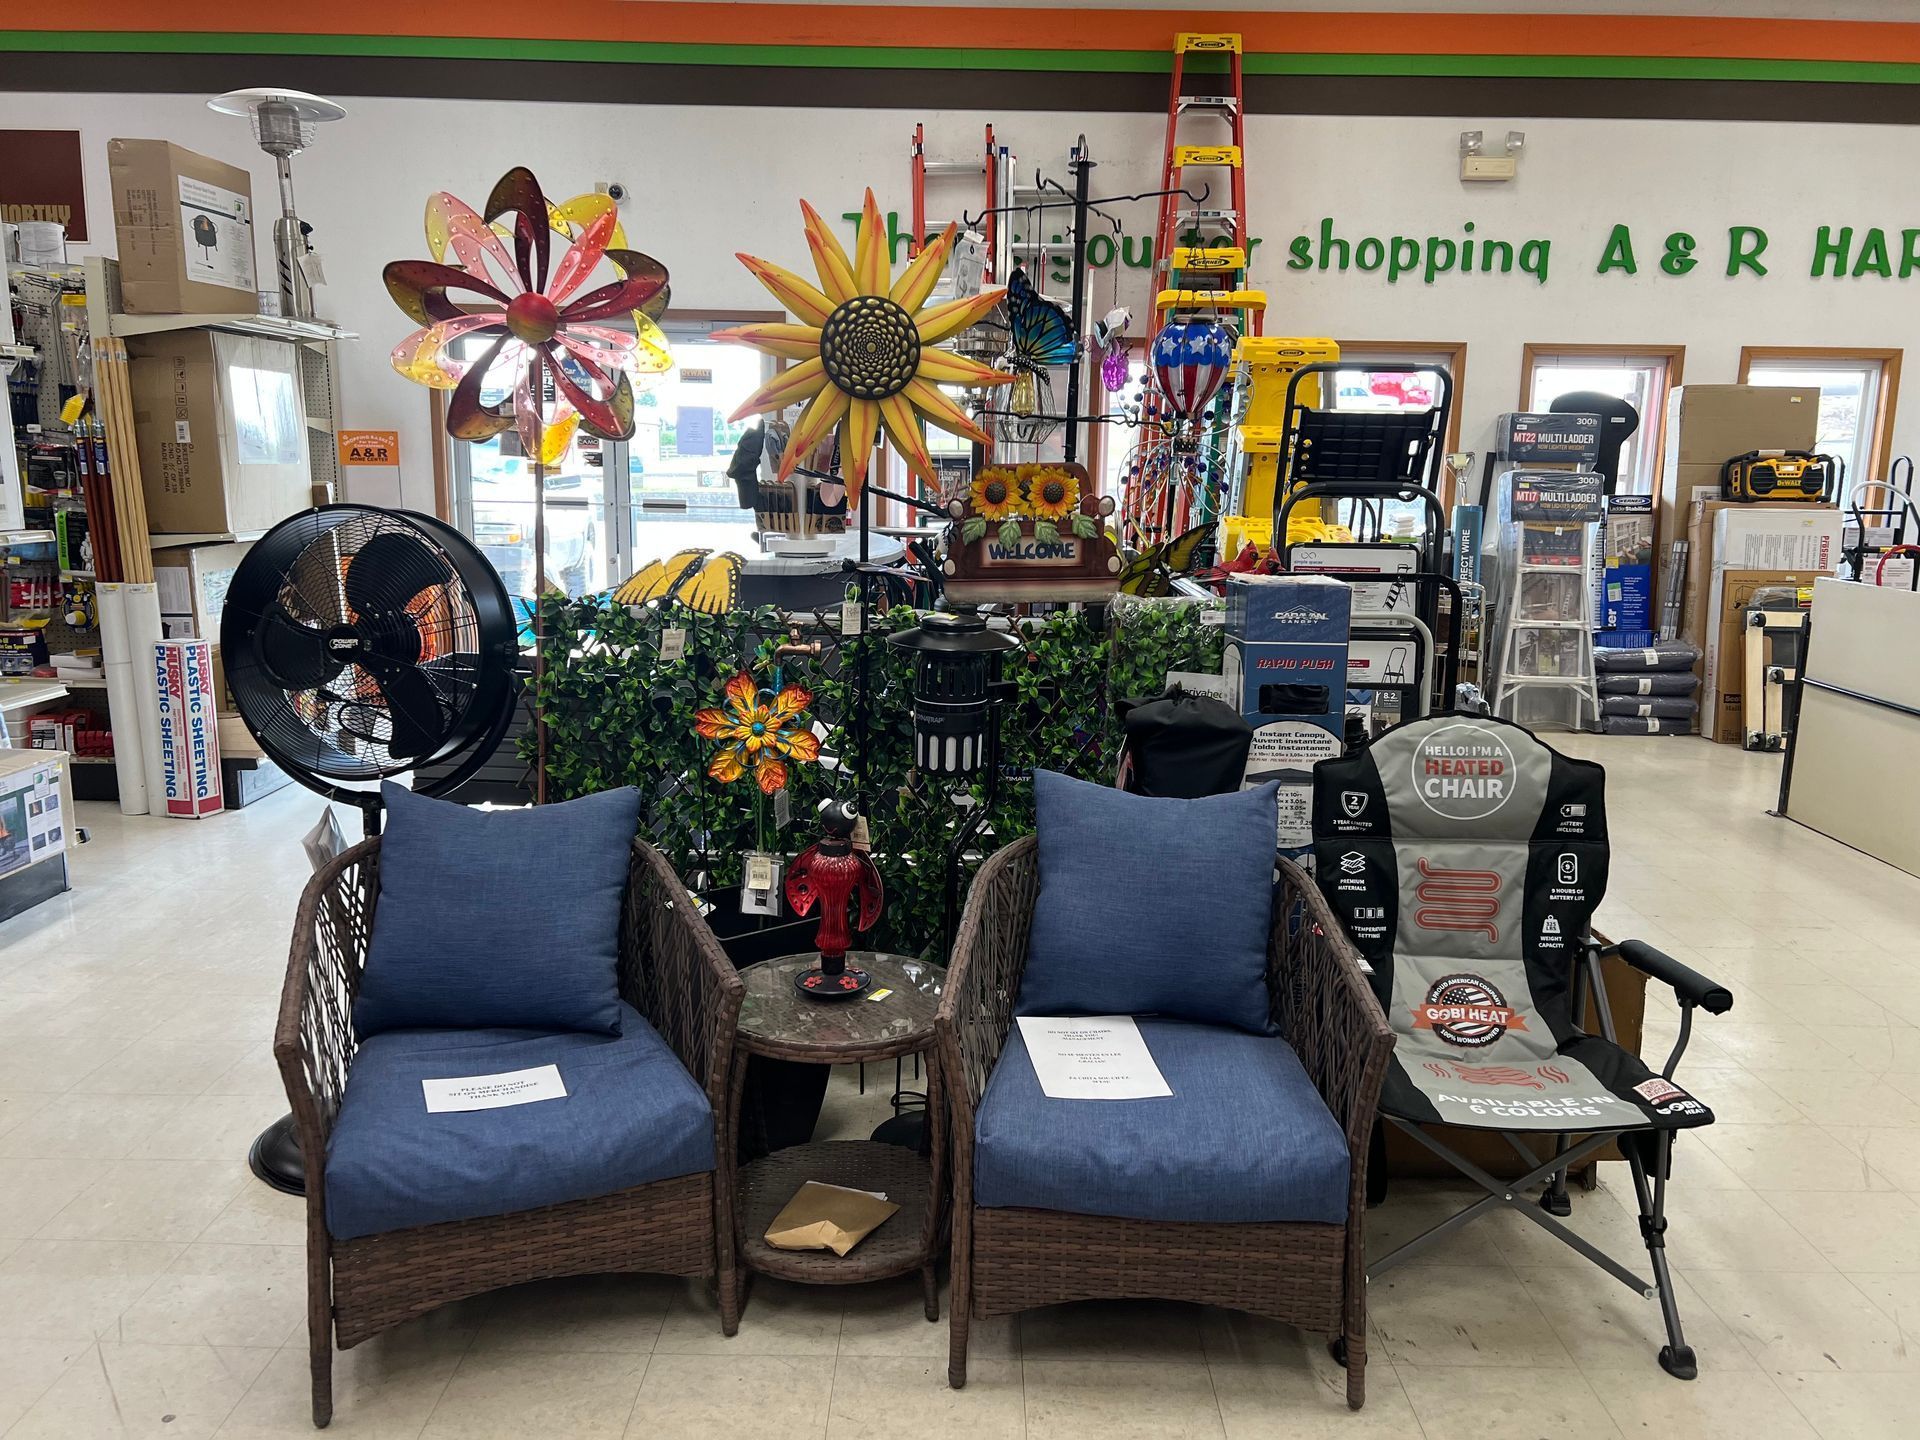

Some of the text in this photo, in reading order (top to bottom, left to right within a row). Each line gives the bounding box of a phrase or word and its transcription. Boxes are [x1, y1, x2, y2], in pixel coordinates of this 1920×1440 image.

[1, 204, 70, 226] ORTHY
[1597, 224, 1638, 275] A
[1660, 232, 1699, 275] &
[1726, 226, 1768, 277] R
[1513, 432, 1594, 444] MT22 MULTI LADDER
[1515, 491, 1597, 503] MT17 MULTI LADDER
[1462, 529, 1471, 553] WIRE
[988, 542, 1076, 560] WELCOME
[1819, 535, 1830, 570] ProSourc
[166, 646, 181, 699] HUSKY
[196, 644, 210, 696] HUSKY
[1256, 658, 1297, 670] RAPID
[1299, 659, 1335, 670] PUSH
[155, 645, 177, 798] PLASTIC SHEETING
[186, 645, 208, 798] PLASTIC SHEETING
[1295, 731, 1325, 739] Canopy
[1425, 745, 1503, 756] HELLO! I'M A
[1425, 758, 1504, 776] HEATED
[1424, 778, 1504, 799] CHAIR
[1351, 796, 1358, 805] 2
[1448, 978, 1480, 986] AMERICAN
[1479, 982, 1502, 1006] COMPANY
[1426, 1008, 1509, 1024] GOBI HEAT
[1440, 1027, 1500, 1044] 100% WOMAN-OWNED
[1438, 1093, 1615, 1108] AVAILABLE IN
[1469, 1104, 1603, 1117] 6 COLORS
